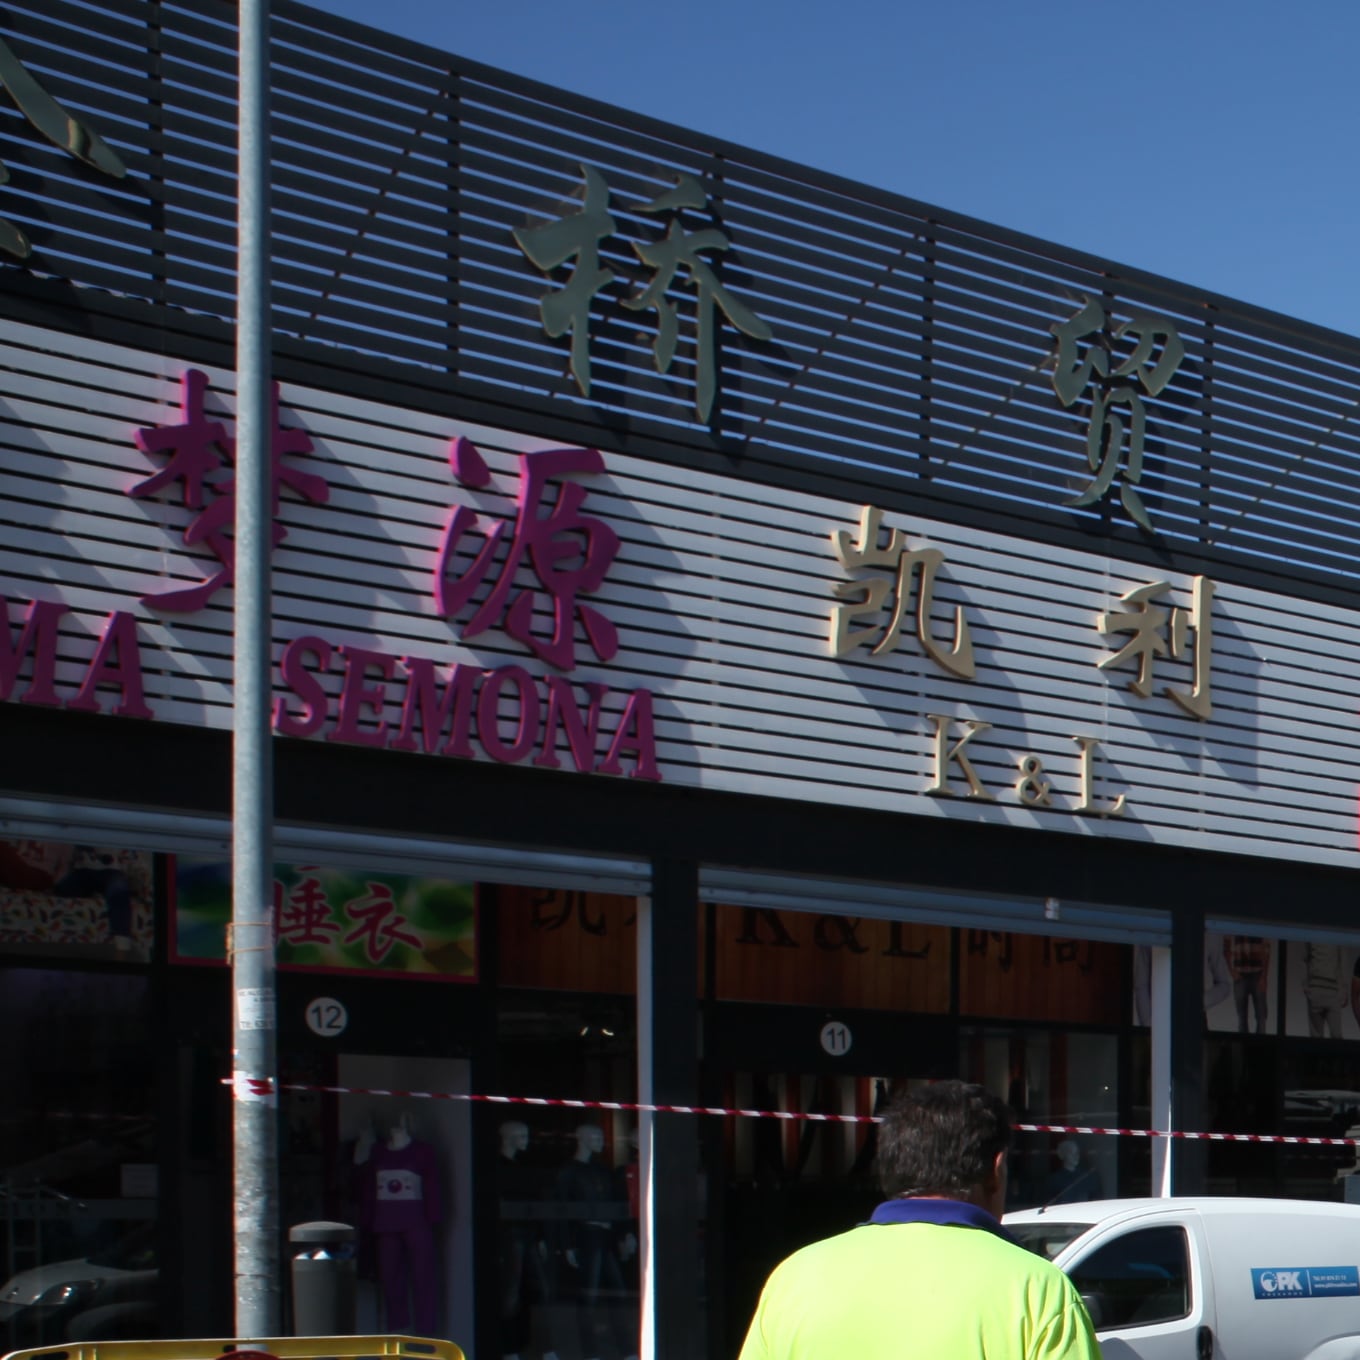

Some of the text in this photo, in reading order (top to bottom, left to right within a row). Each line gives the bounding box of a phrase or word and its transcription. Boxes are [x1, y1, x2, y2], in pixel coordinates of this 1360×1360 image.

[829, 504, 1217, 721] 凯利
[272, 636, 662, 781] SEMONA
[310, 1006, 342, 1029] 12
[825, 1029, 849, 1050] 11
[1276, 1271, 1303, 1291] PK
